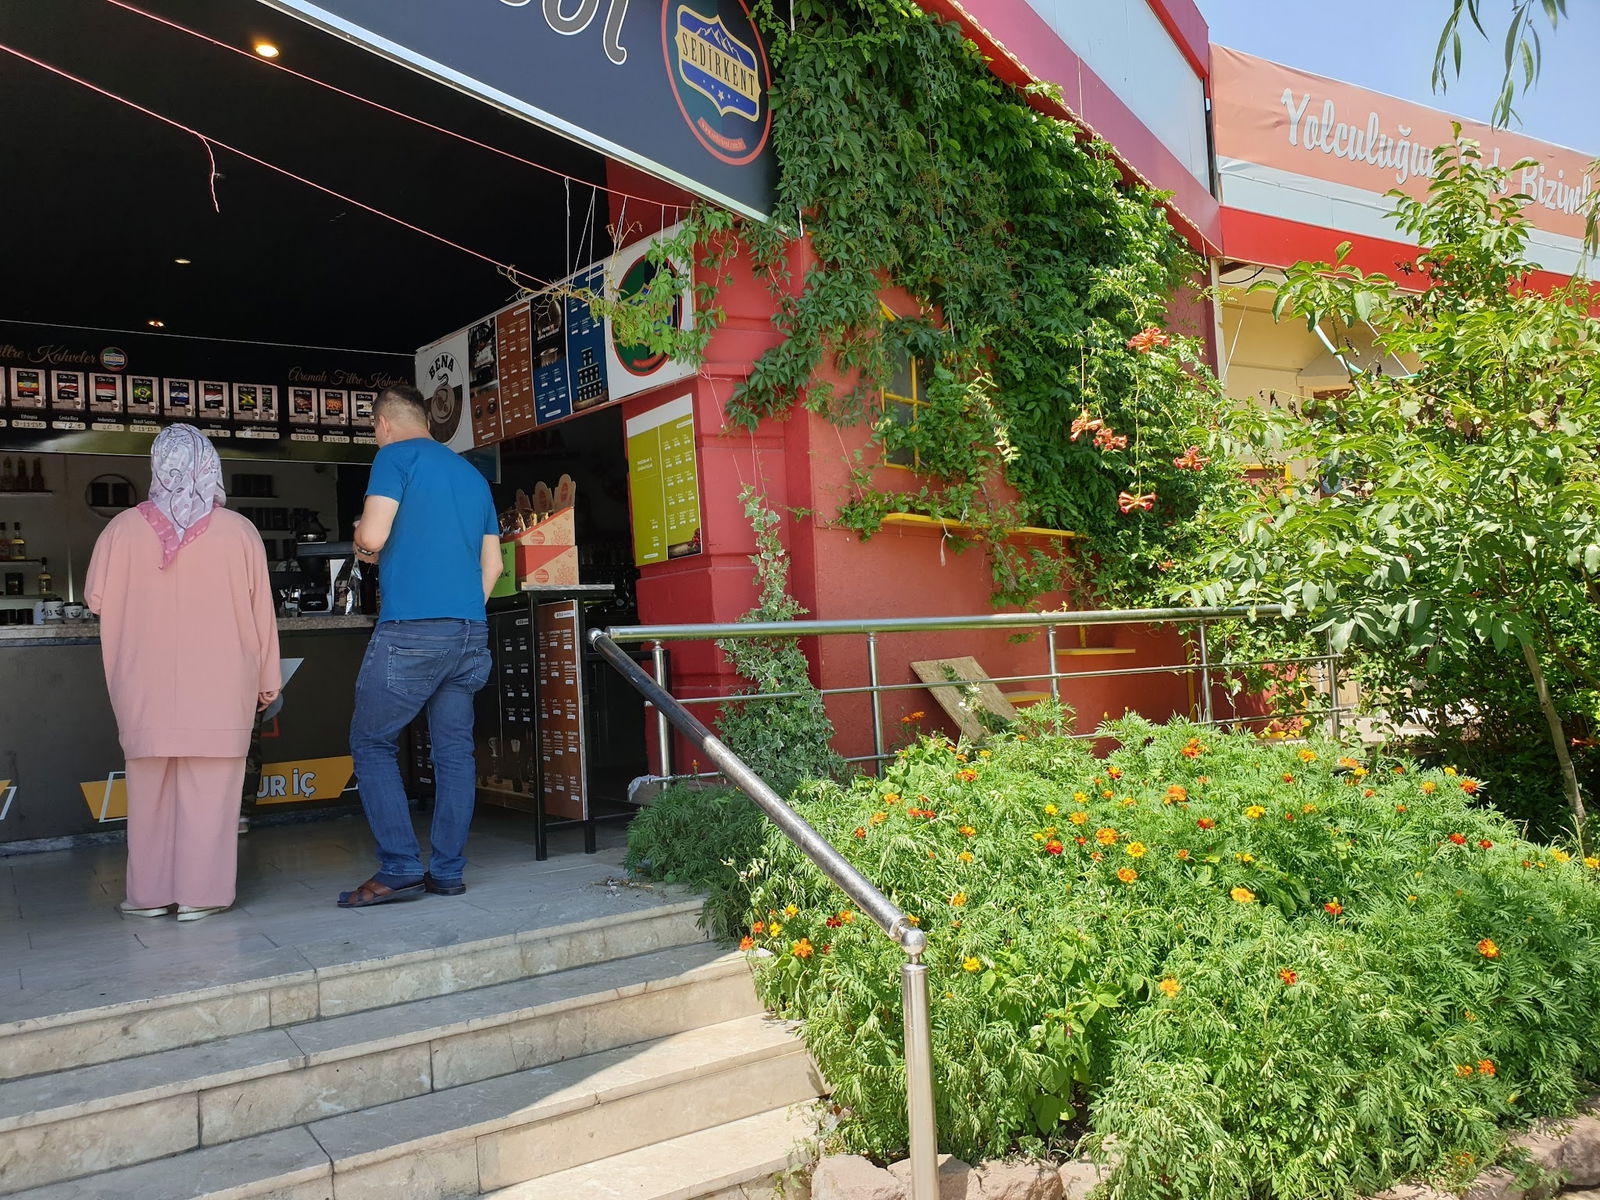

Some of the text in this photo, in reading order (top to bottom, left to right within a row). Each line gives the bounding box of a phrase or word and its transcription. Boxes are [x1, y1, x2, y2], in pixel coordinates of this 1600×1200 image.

[682, 32, 755, 97] SEDİRKENT
[1519, 156, 1600, 221] Biziml
[429, 355, 454, 380] BENA
[292, 768, 317, 799] İÇ
